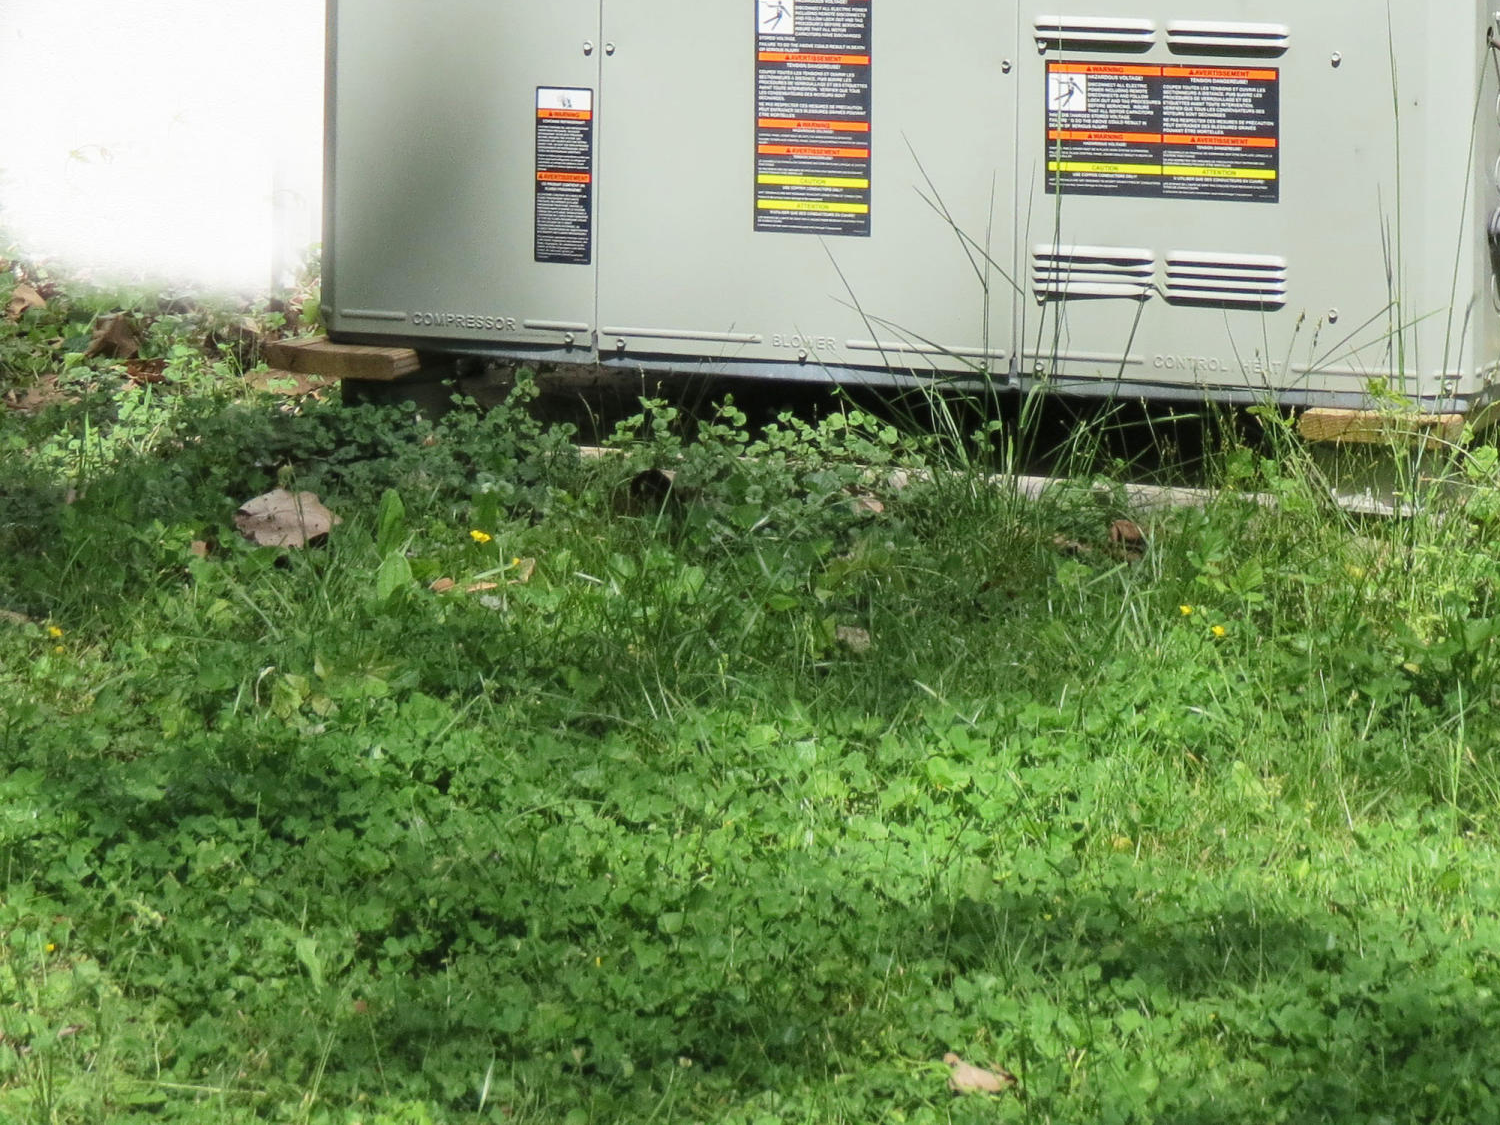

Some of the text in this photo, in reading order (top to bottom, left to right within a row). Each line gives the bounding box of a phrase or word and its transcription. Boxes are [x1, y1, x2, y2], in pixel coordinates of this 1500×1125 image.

[413, 311, 516, 331] COMPRESSOR
[772, 333, 837, 351] BLOWER
[1153, 355, 1229, 372] CONTROL
